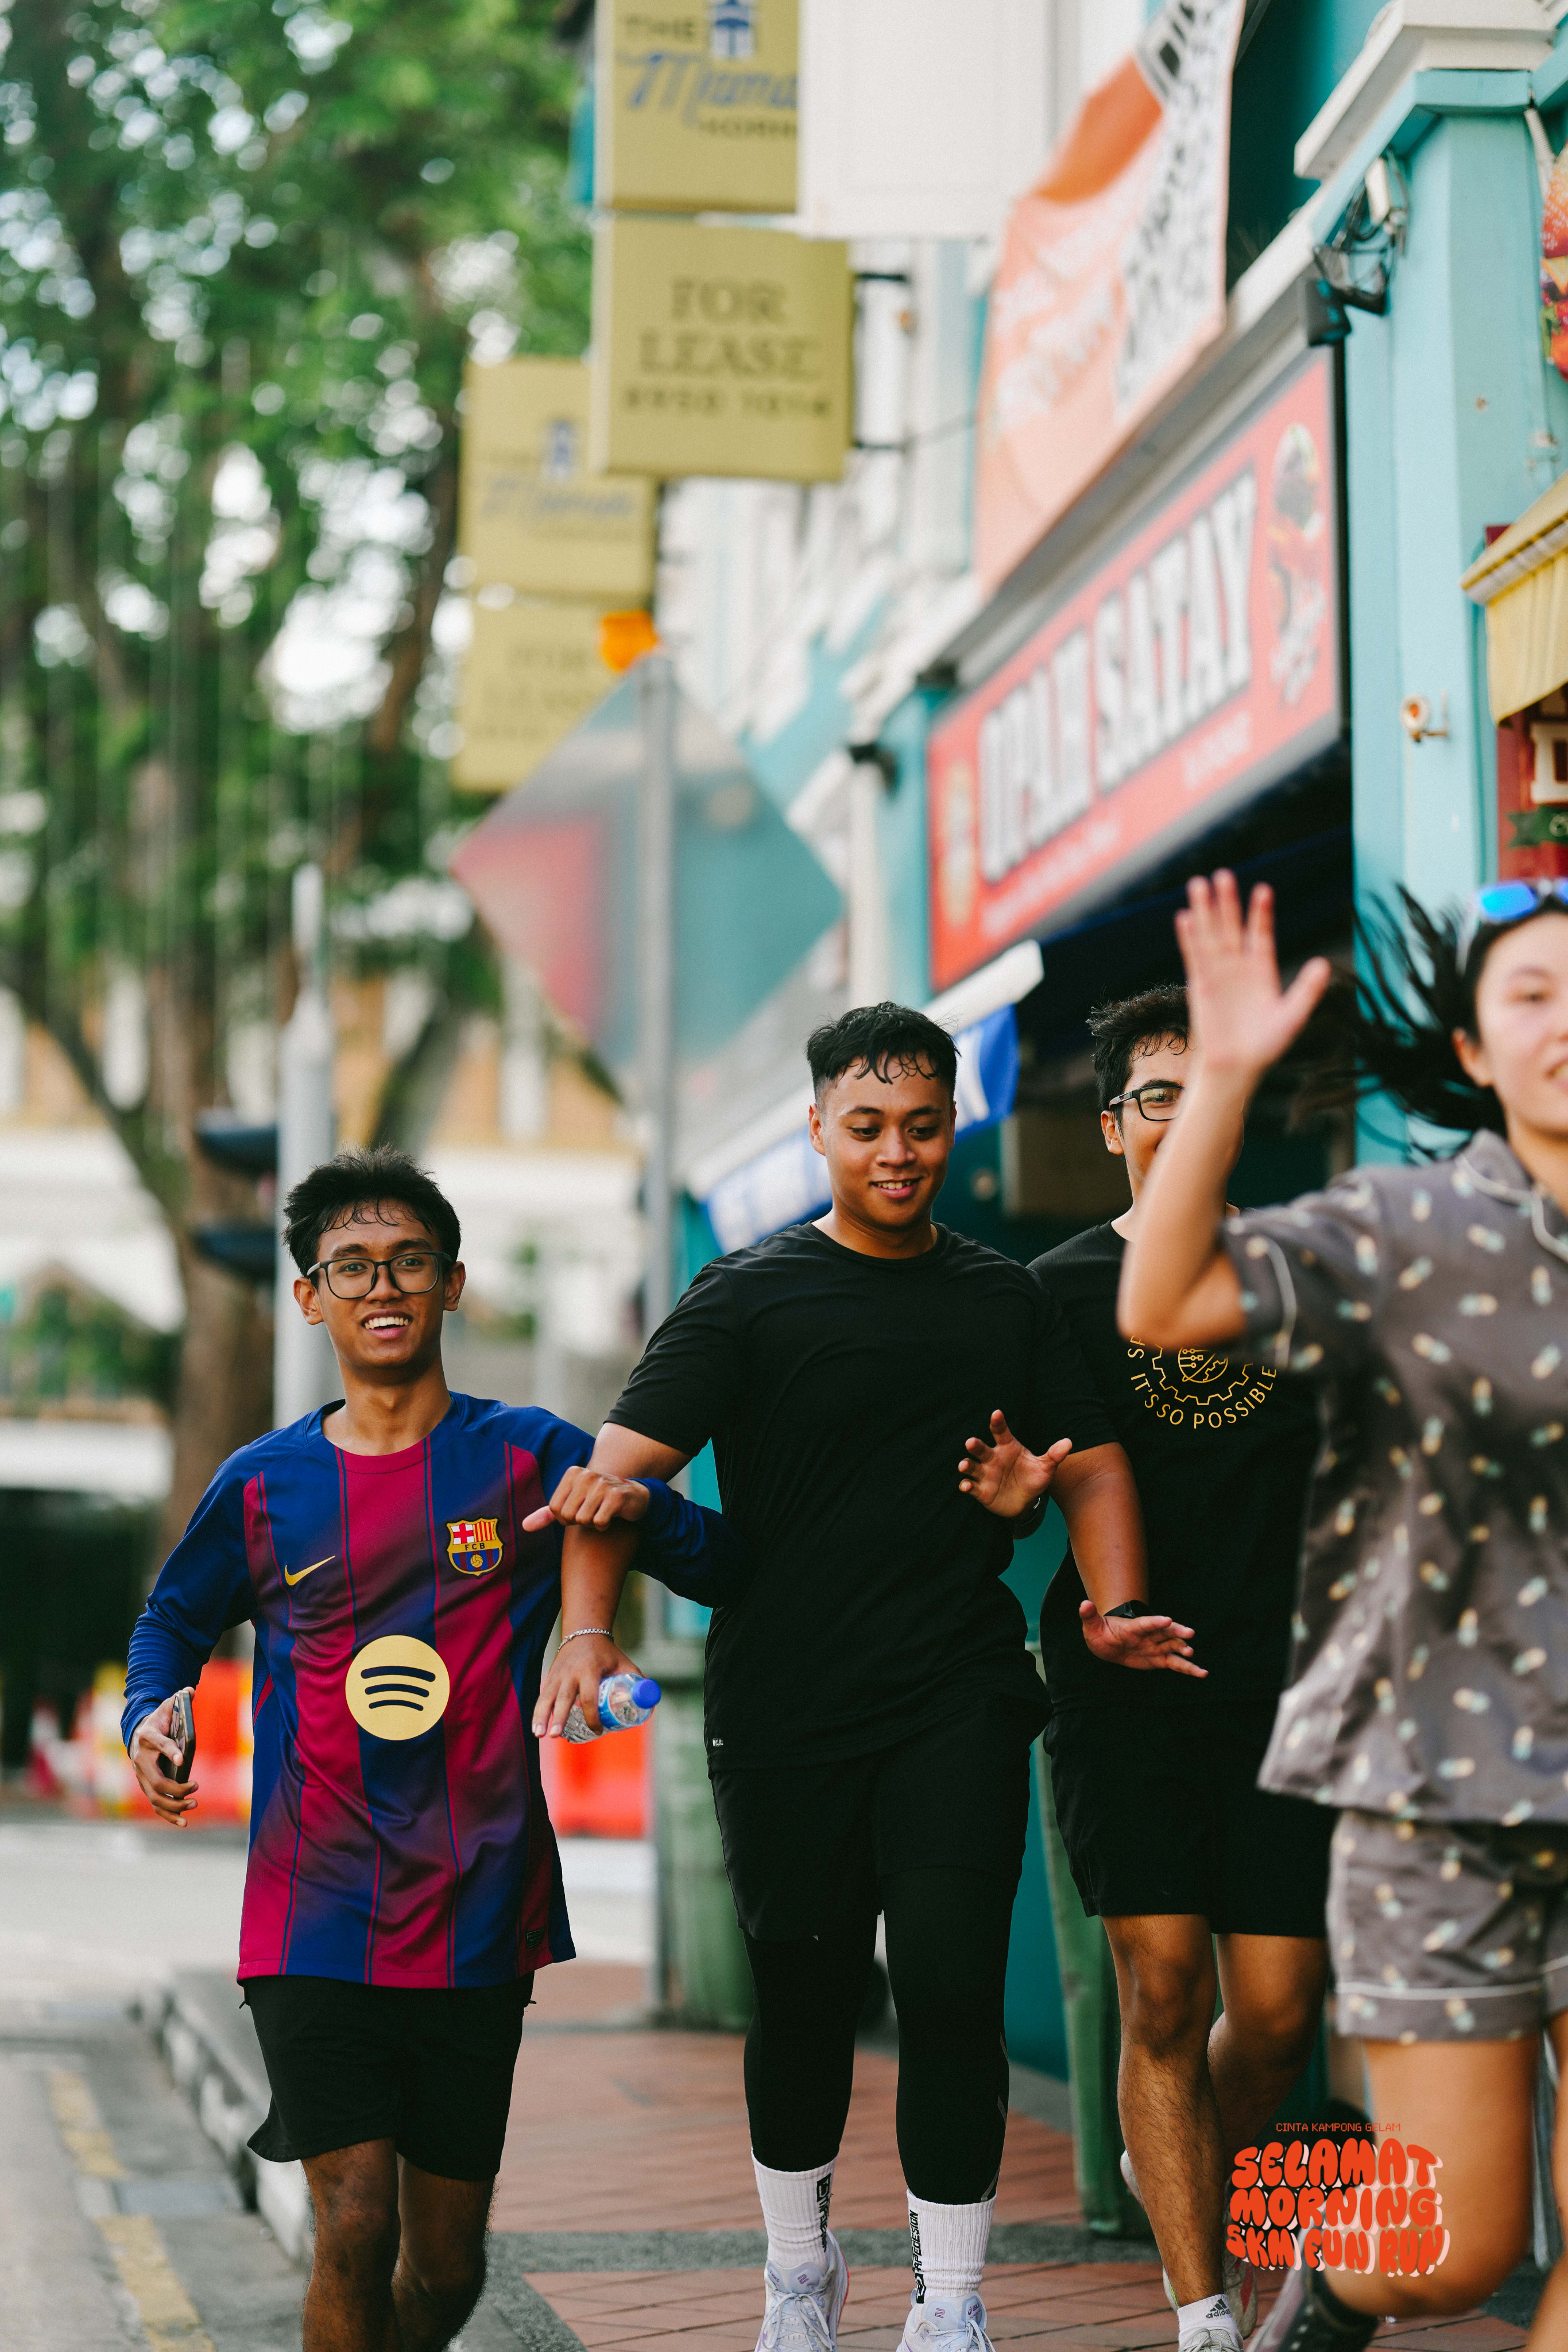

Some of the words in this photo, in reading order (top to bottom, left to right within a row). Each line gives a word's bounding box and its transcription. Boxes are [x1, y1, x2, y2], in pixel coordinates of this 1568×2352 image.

[671, 276, 789, 325] FOR
[638, 328, 822, 381] LEASE
[1093, 464, 1259, 798] SATAY
[1130, 1373, 1159, 1409] IT'S
[1156, 1404, 1184, 1425] SO
[1194, 1365, 1277, 1429] POSSIBLE
[464, 1542, 485, 1551] FCB
